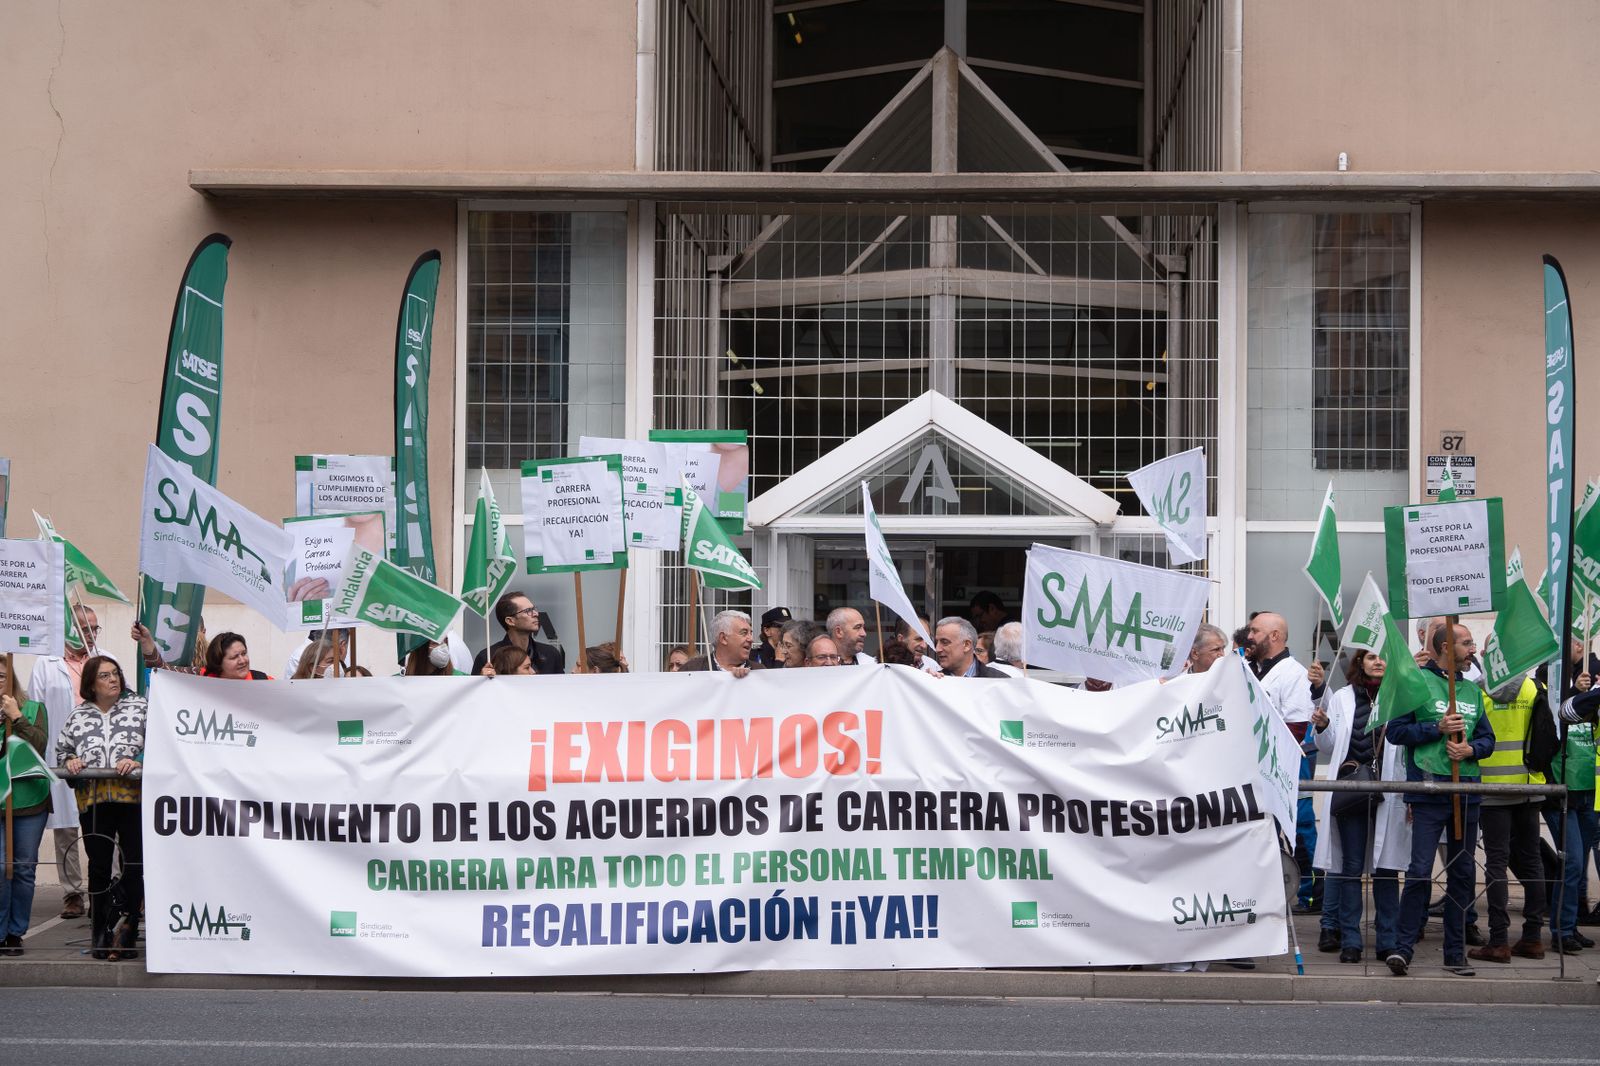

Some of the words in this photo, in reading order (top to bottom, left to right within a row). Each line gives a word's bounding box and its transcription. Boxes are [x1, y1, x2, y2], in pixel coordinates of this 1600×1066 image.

[182, 349, 218, 381] SATSE
[1442, 436, 1463, 450] 87
[623, 455, 646, 463] RRERA
[622, 465, 647, 474] SIONAL
[318, 484, 374, 492] CUMPLIMIENTO
[555, 484, 591, 493] CARRERA
[334, 495, 373, 503] ACUERDOS
[548, 496, 600, 507] PROFESIONAL
[623, 499, 663, 509] FICACIÓN
[154, 477, 262, 564] SMA
[543, 513, 608, 526] ¡RECALIFICACIÓN
[624, 512, 634, 520] A!
[569, 529, 584, 538] YA!
[1420, 525, 1443, 534] SATSE
[1445, 524, 1461, 532] POR
[1463, 522, 1473, 530] LA
[153, 531, 195, 550] Sindicato
[1429, 534, 1465, 543] CARRERA
[305, 550, 331, 559] Carrera
[1410, 545, 1462, 555] PROFESIONAL
[1464, 542, 1485, 551] PARA
[10, 560, 25, 569] POR
[27, 561, 36, 569] LA
[305, 560, 342, 572] Profesional
[0, 569, 28, 579] ARRERA
[1412, 577, 1434, 586] TODO
[1446, 572, 1486, 583] PERSONAL
[0, 580, 25, 589] SIONAL
[27, 582, 46, 590] PARA
[335, 550, 374, 615] Andalucía
[1428, 585, 1470, 595] TEMPORAL
[9, 612, 46, 622] PERSONAL
[1038, 571, 1173, 652] SMA
[1142, 610, 1186, 632] Sevilla
[364, 602, 440, 635] SATSE
[0, 622, 30, 631] MPORAL
[1037, 634, 1066, 648] Sindicato
[176, 709, 252, 741] SMA
[234, 721, 260, 729] Sevilla
[1156, 702, 1218, 740] SMA
[1027, 731, 1059, 740] Sindicato
[528, 710, 883, 791] ¡EXIGIMOS!
[153, 796, 421, 843] CUMPLIMENTO
[433, 801, 478, 842] DE
[488, 800, 556, 841] LOS
[565, 794, 769, 840] ACUERDOS
[779, 792, 823, 833] DE
[837, 790, 1010, 832] CARRERA
[1017, 783, 1265, 837] PROFESIONAL
[366, 858, 509, 891] CARRERA
[516, 855, 597, 889] PARA
[603, 853, 686, 888] TODO
[695, 853, 725, 885] EL
[733, 847, 887, 884] PERSONAL
[893, 847, 1054, 881] TEMPORAL
[1172, 892, 1251, 926] SMA
[1232, 898, 1257, 909] Sevilla
[169, 902, 246, 937] SMA
[227, 913, 252, 922] Sevilla
[482, 889, 819, 947] RECALIFICACIÓN
[831, 895, 939, 945] ¡¡YA!!
[360, 922, 392, 930] Sindicato
